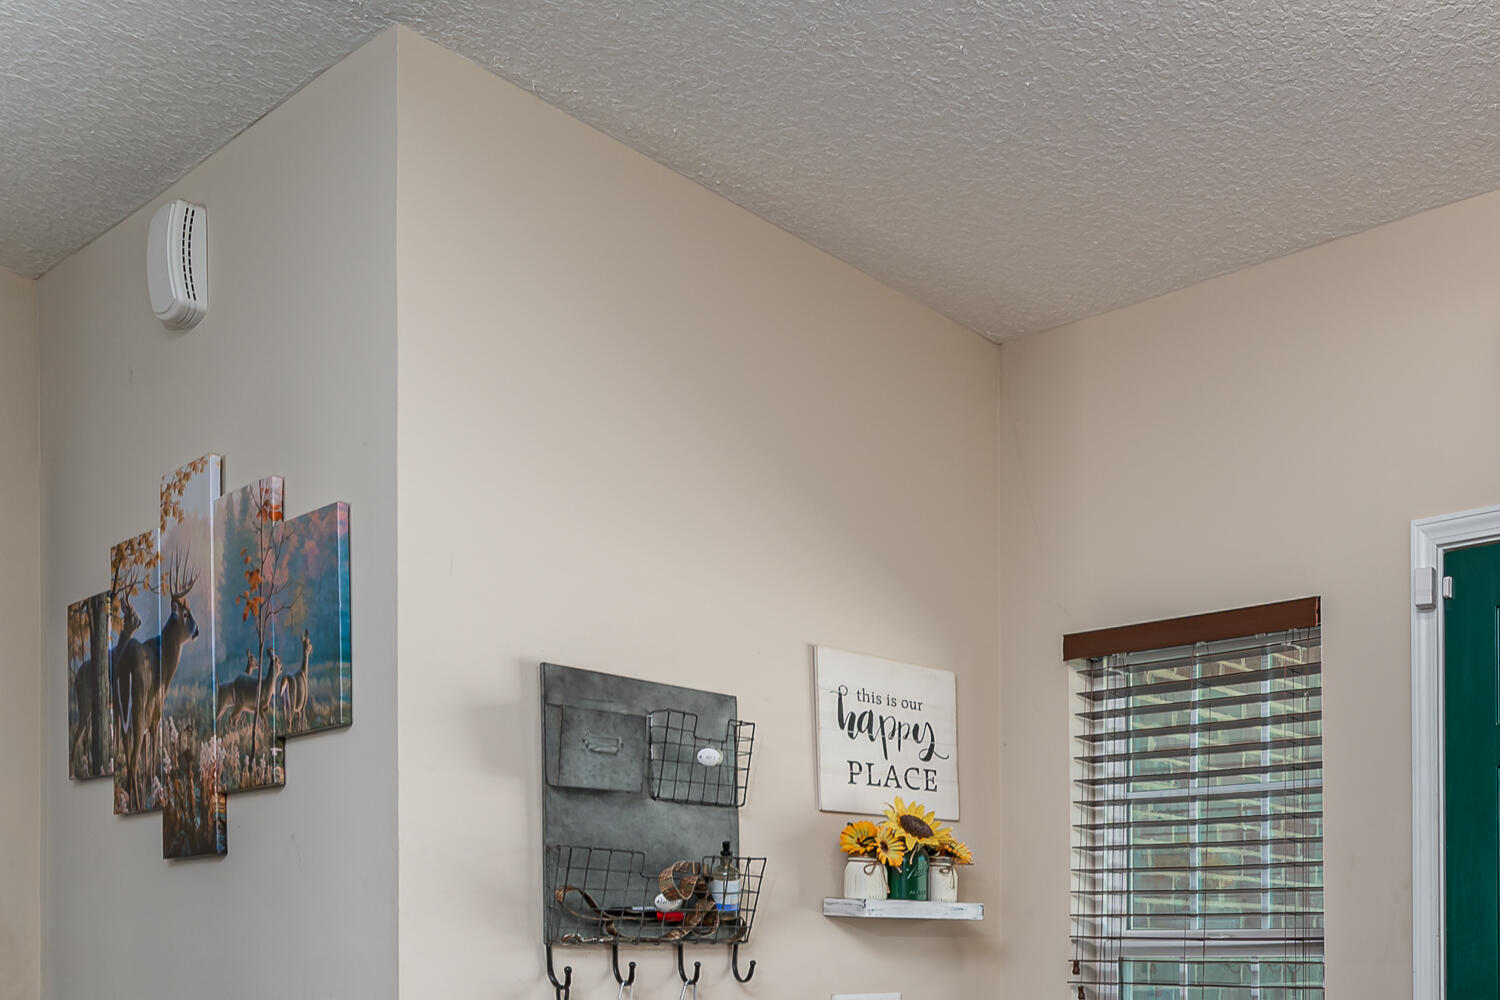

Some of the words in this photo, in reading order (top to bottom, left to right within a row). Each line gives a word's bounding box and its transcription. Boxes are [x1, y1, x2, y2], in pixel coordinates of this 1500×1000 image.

[856, 687, 882, 705] this
[886, 693, 897, 707] is
[901, 699, 923, 711] our
[829, 684, 950, 762] happy
[846, 760, 938, 792] PLACE
